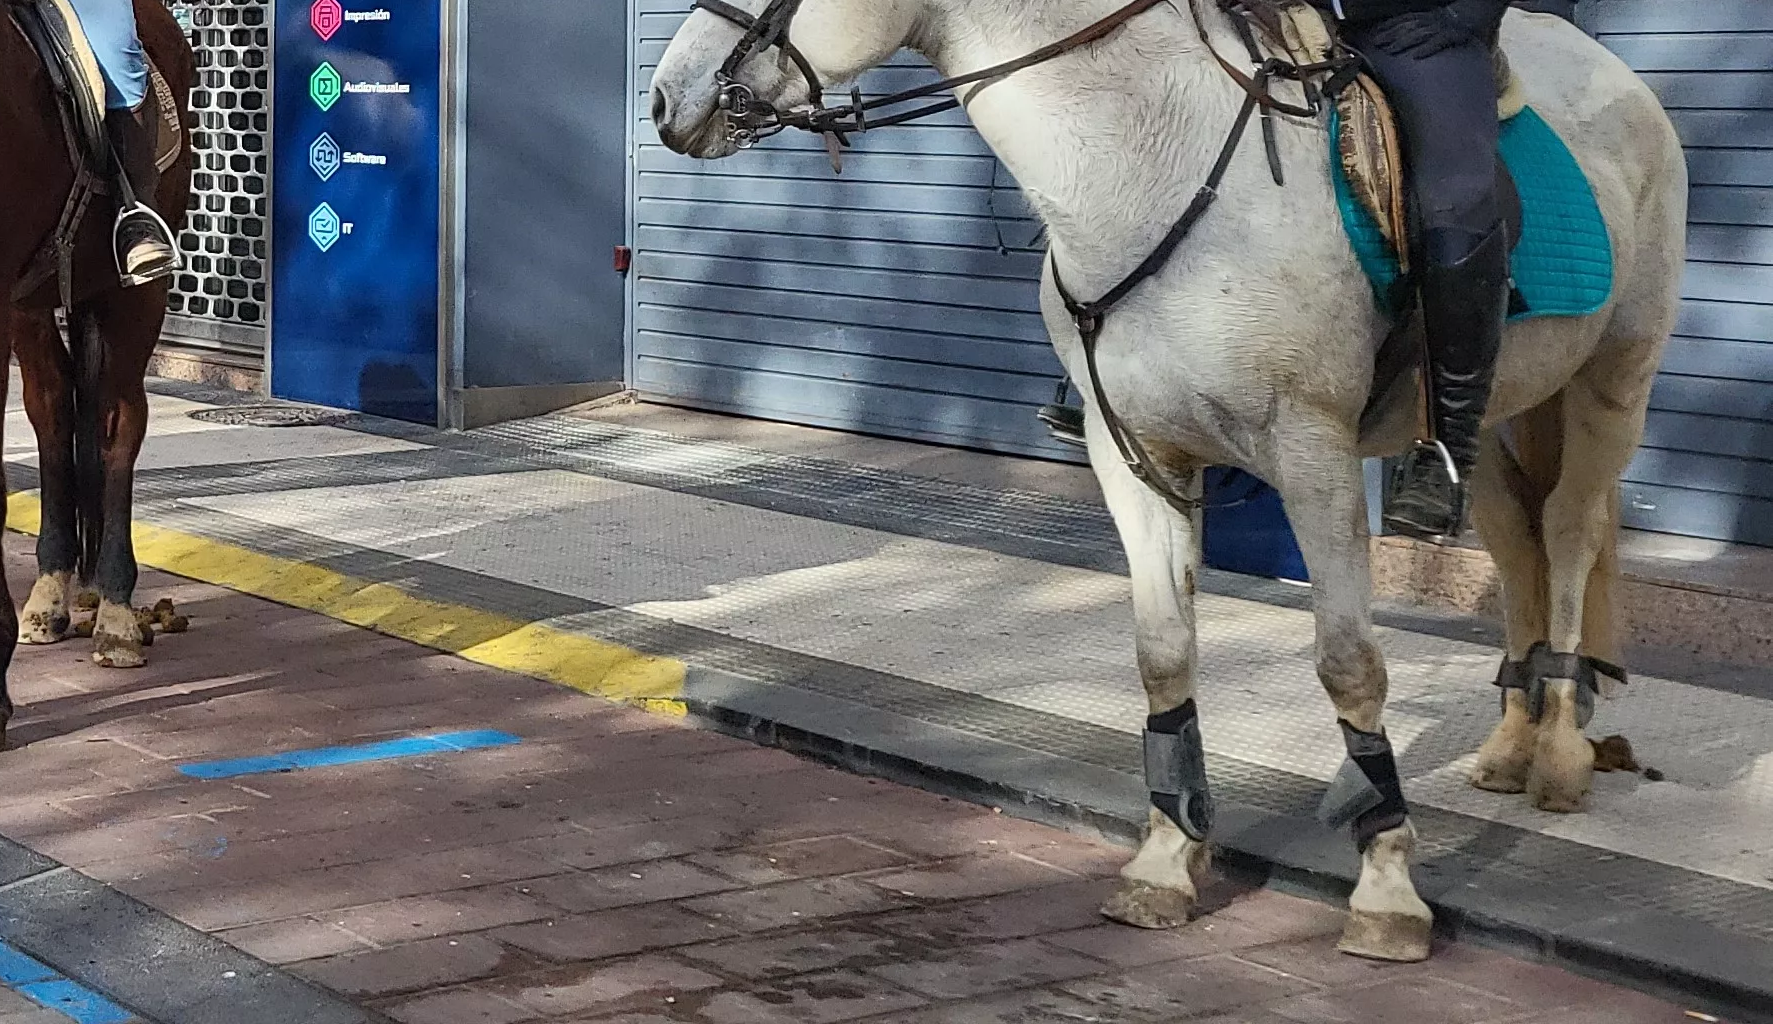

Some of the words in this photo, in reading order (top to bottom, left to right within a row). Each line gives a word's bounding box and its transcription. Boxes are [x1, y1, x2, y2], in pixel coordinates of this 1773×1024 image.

[344, 9, 390, 22] Impresión
[343, 81, 410, 93] Audiovisuales
[343, 152, 387, 165] Software
[342, 222, 353, 234] IT
